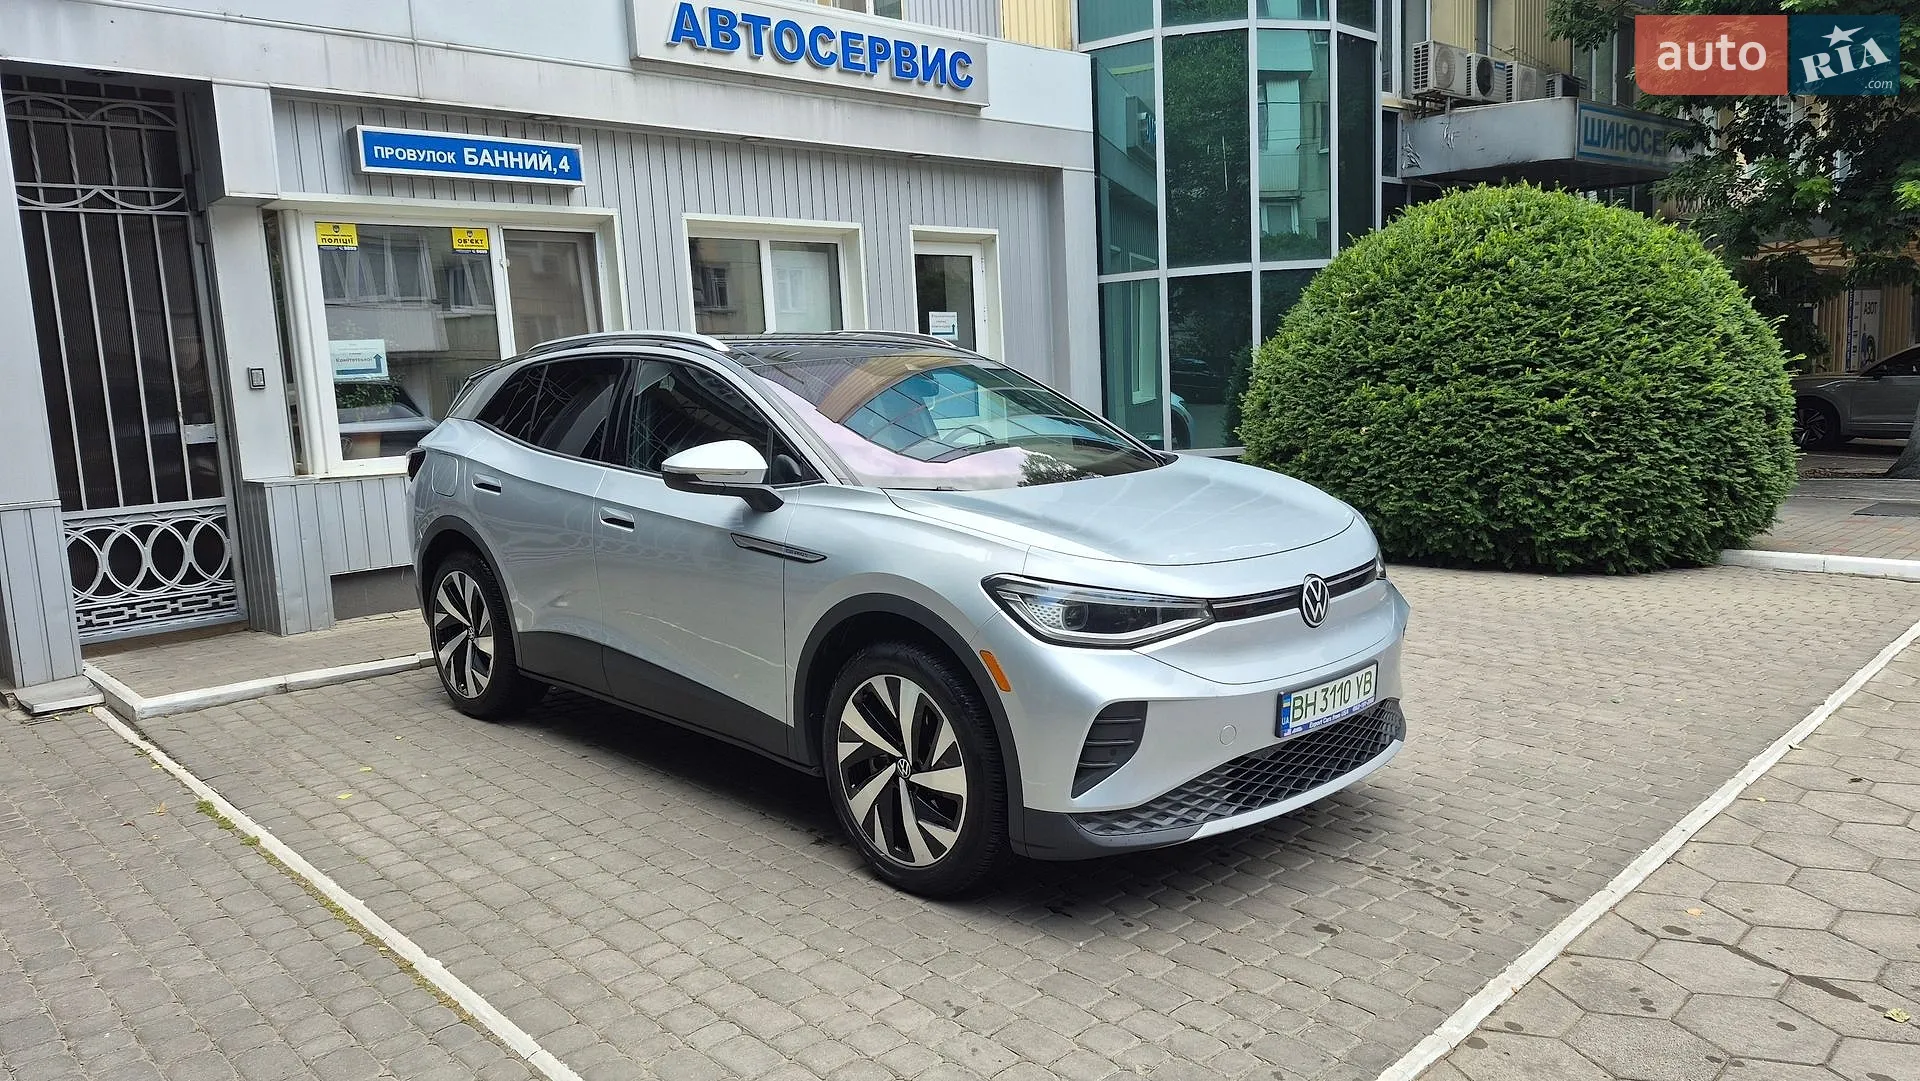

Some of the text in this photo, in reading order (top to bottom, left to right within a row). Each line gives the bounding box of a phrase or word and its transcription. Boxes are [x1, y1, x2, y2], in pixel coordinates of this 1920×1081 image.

[667, 2, 974, 91] АВТОСЕРВИС
[373, 145, 456, 164] ПРОВУЛОК
[321, 237, 354, 245] ПОЛІЦІЇ
[1291, 690, 1317, 723] BH
[1319, 679, 1352, 713] 3110
[1356, 670, 1373, 699] YB
[1281, 717, 1290, 726] UA
